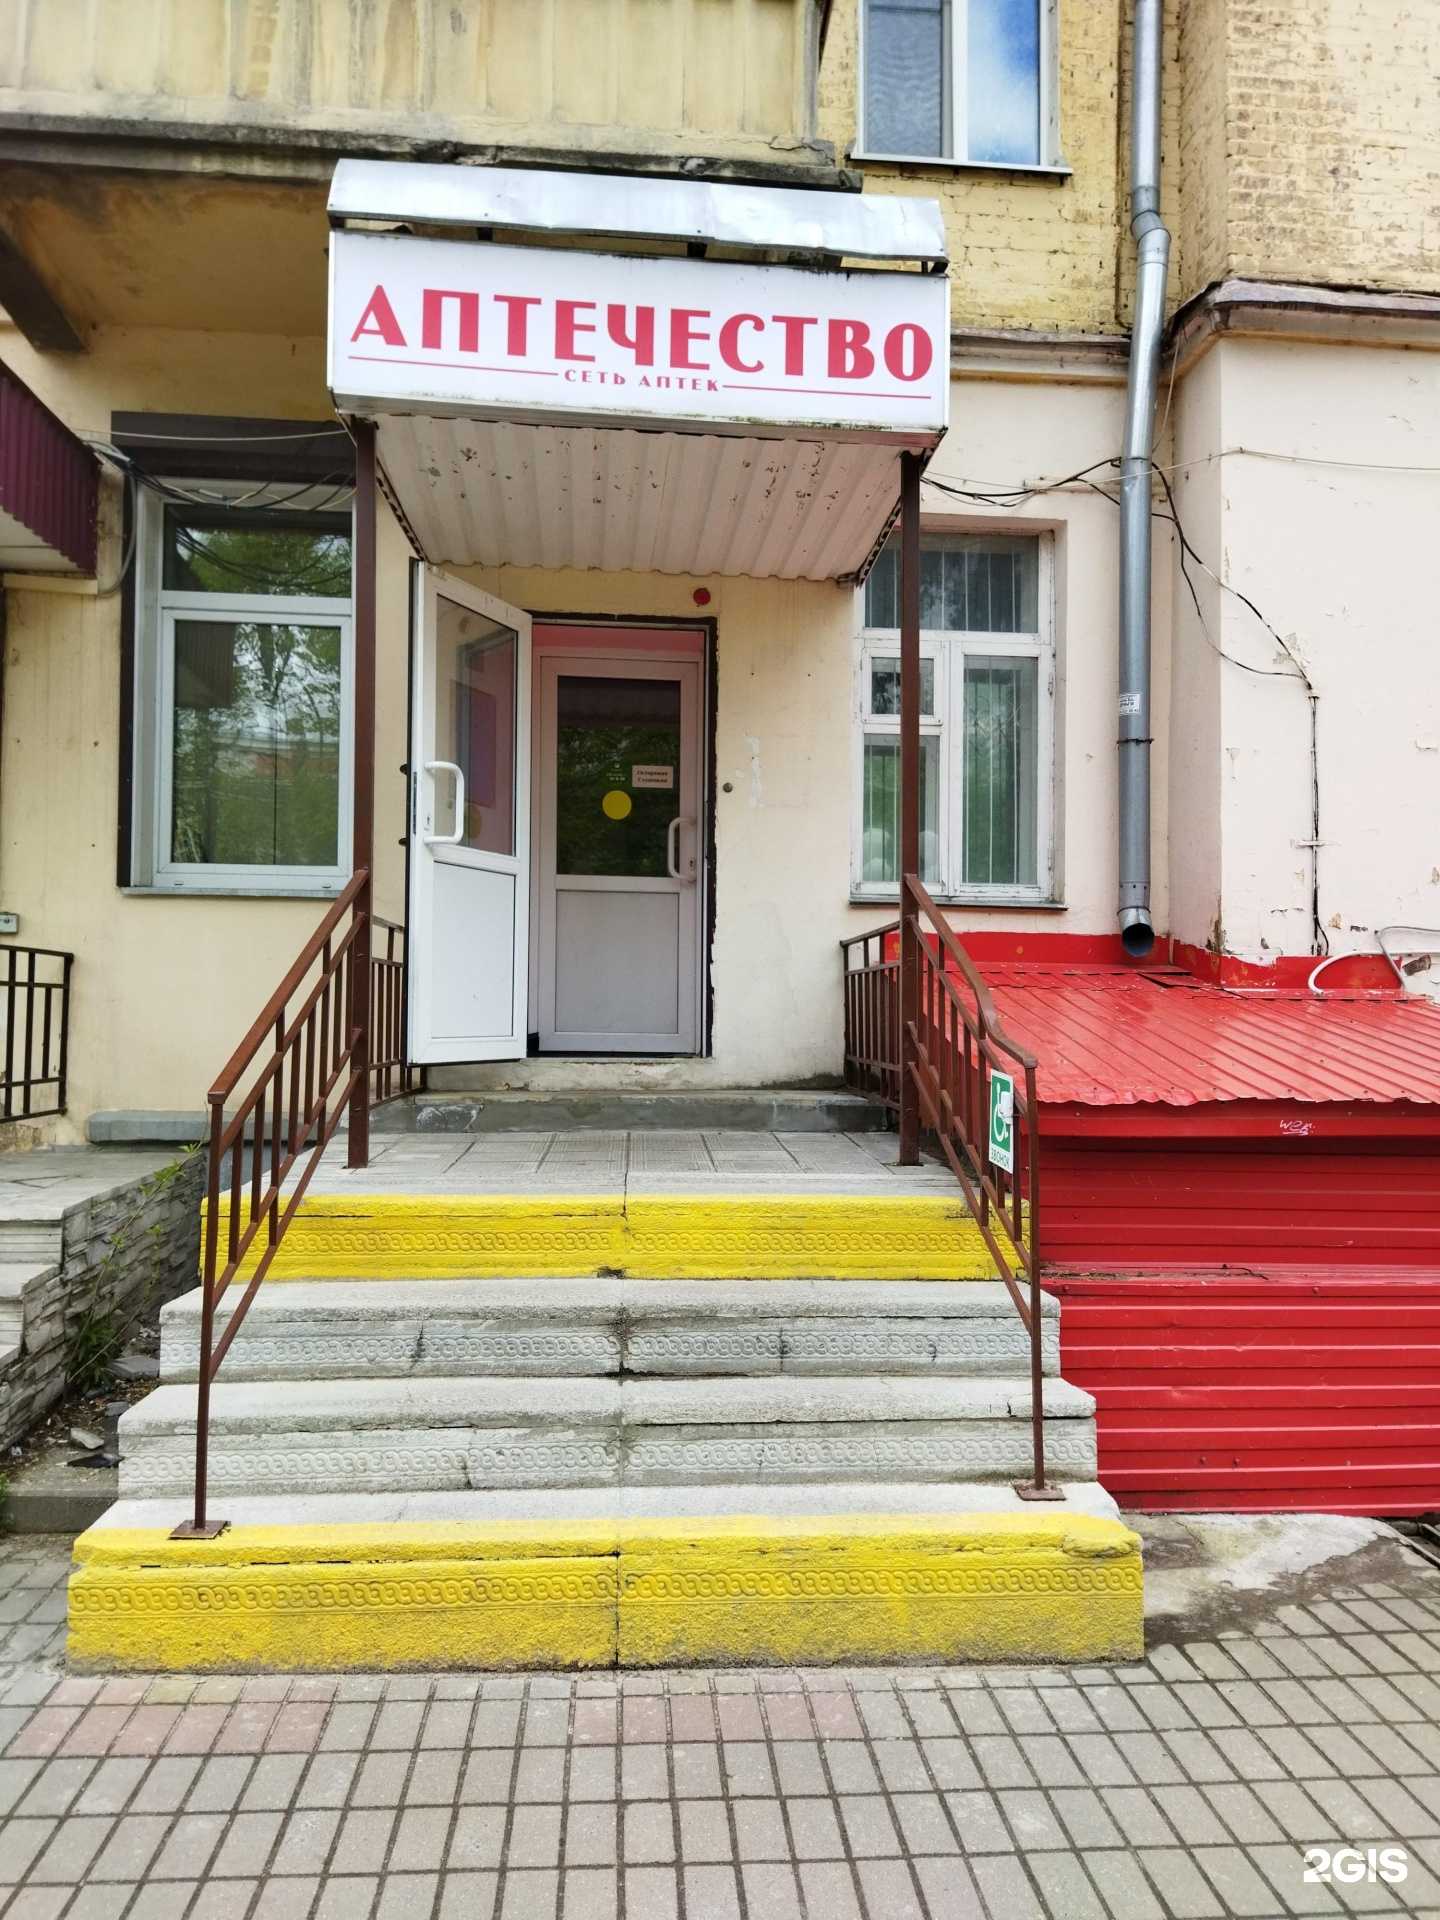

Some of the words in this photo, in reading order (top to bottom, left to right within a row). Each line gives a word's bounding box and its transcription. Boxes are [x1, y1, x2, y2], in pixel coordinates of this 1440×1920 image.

[350, 284, 934, 383] АПТЕЧЕСТВО
[564, 369, 626, 385] СЕТЬ
[638, 375, 718, 391] АПТЕК
